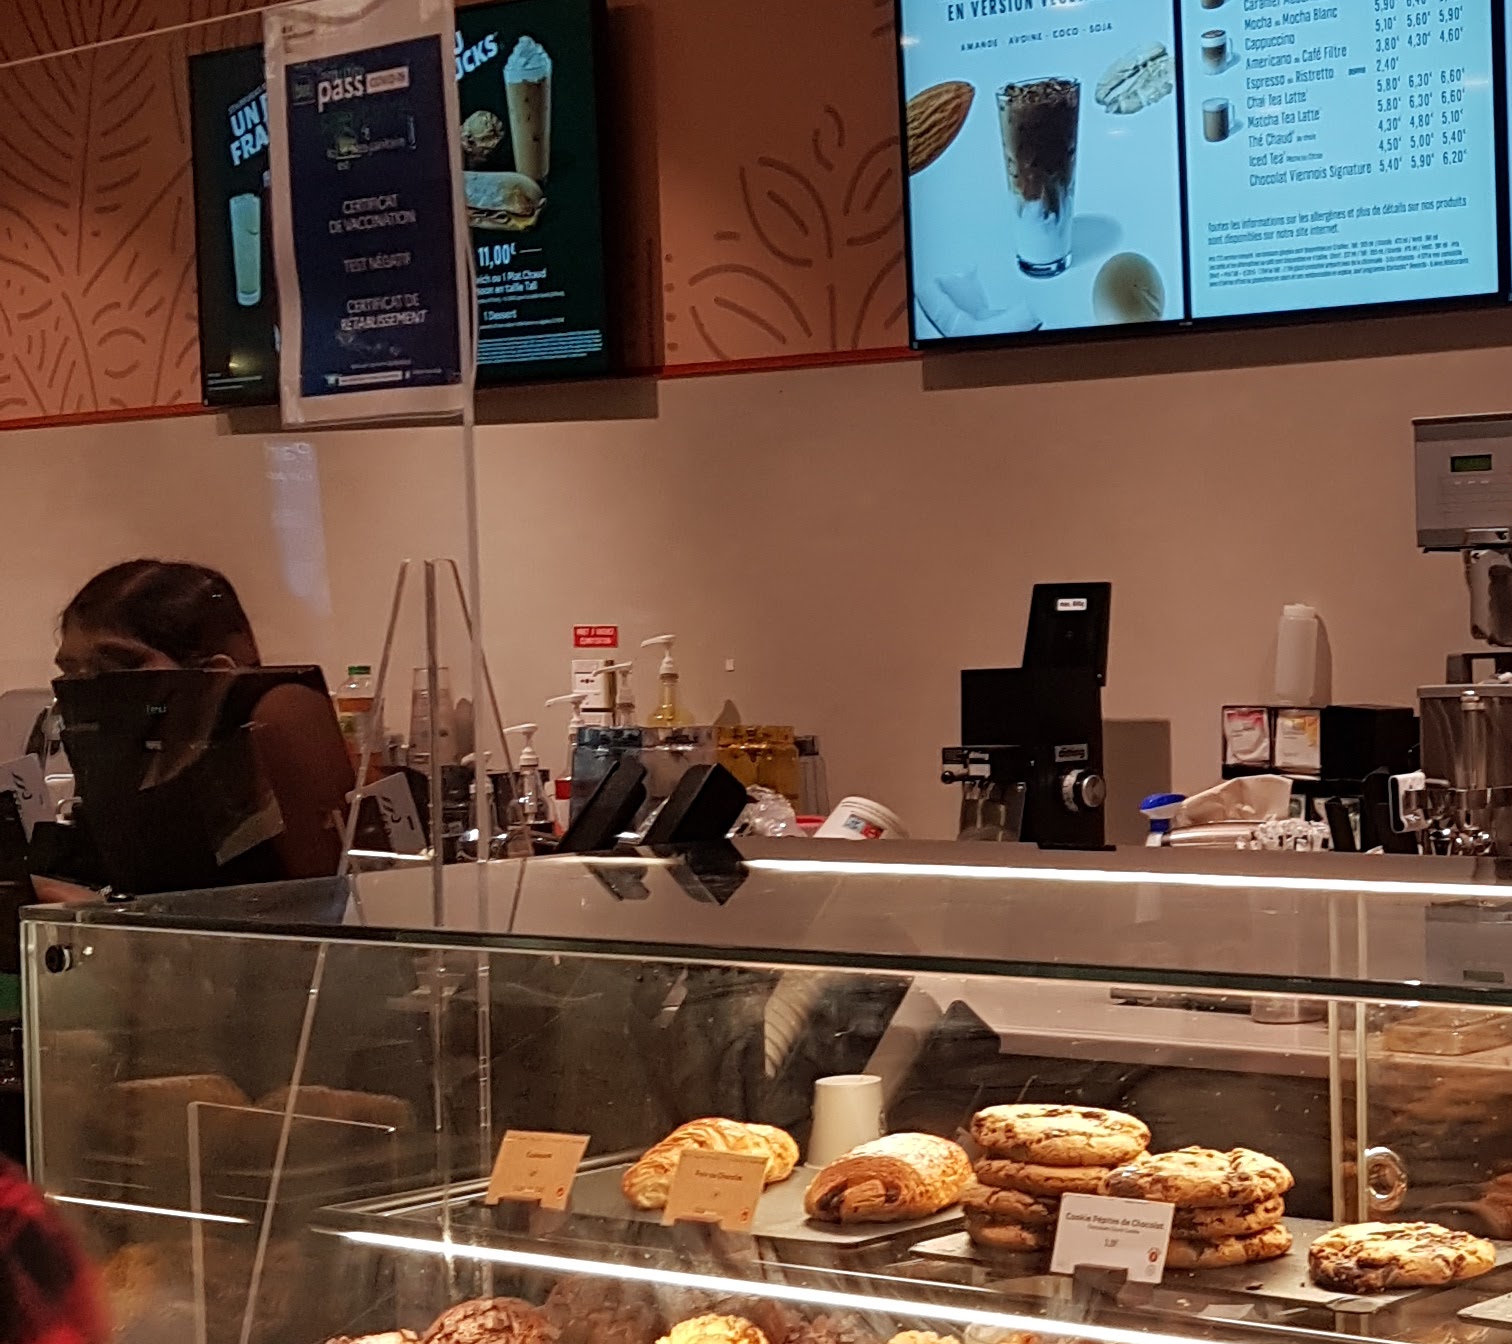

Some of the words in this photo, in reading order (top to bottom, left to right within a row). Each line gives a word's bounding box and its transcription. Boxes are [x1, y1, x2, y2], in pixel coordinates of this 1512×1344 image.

[948, 4, 964, 22] EN
[318, 75, 364, 113] pass
[230, 100, 260, 136] UN
